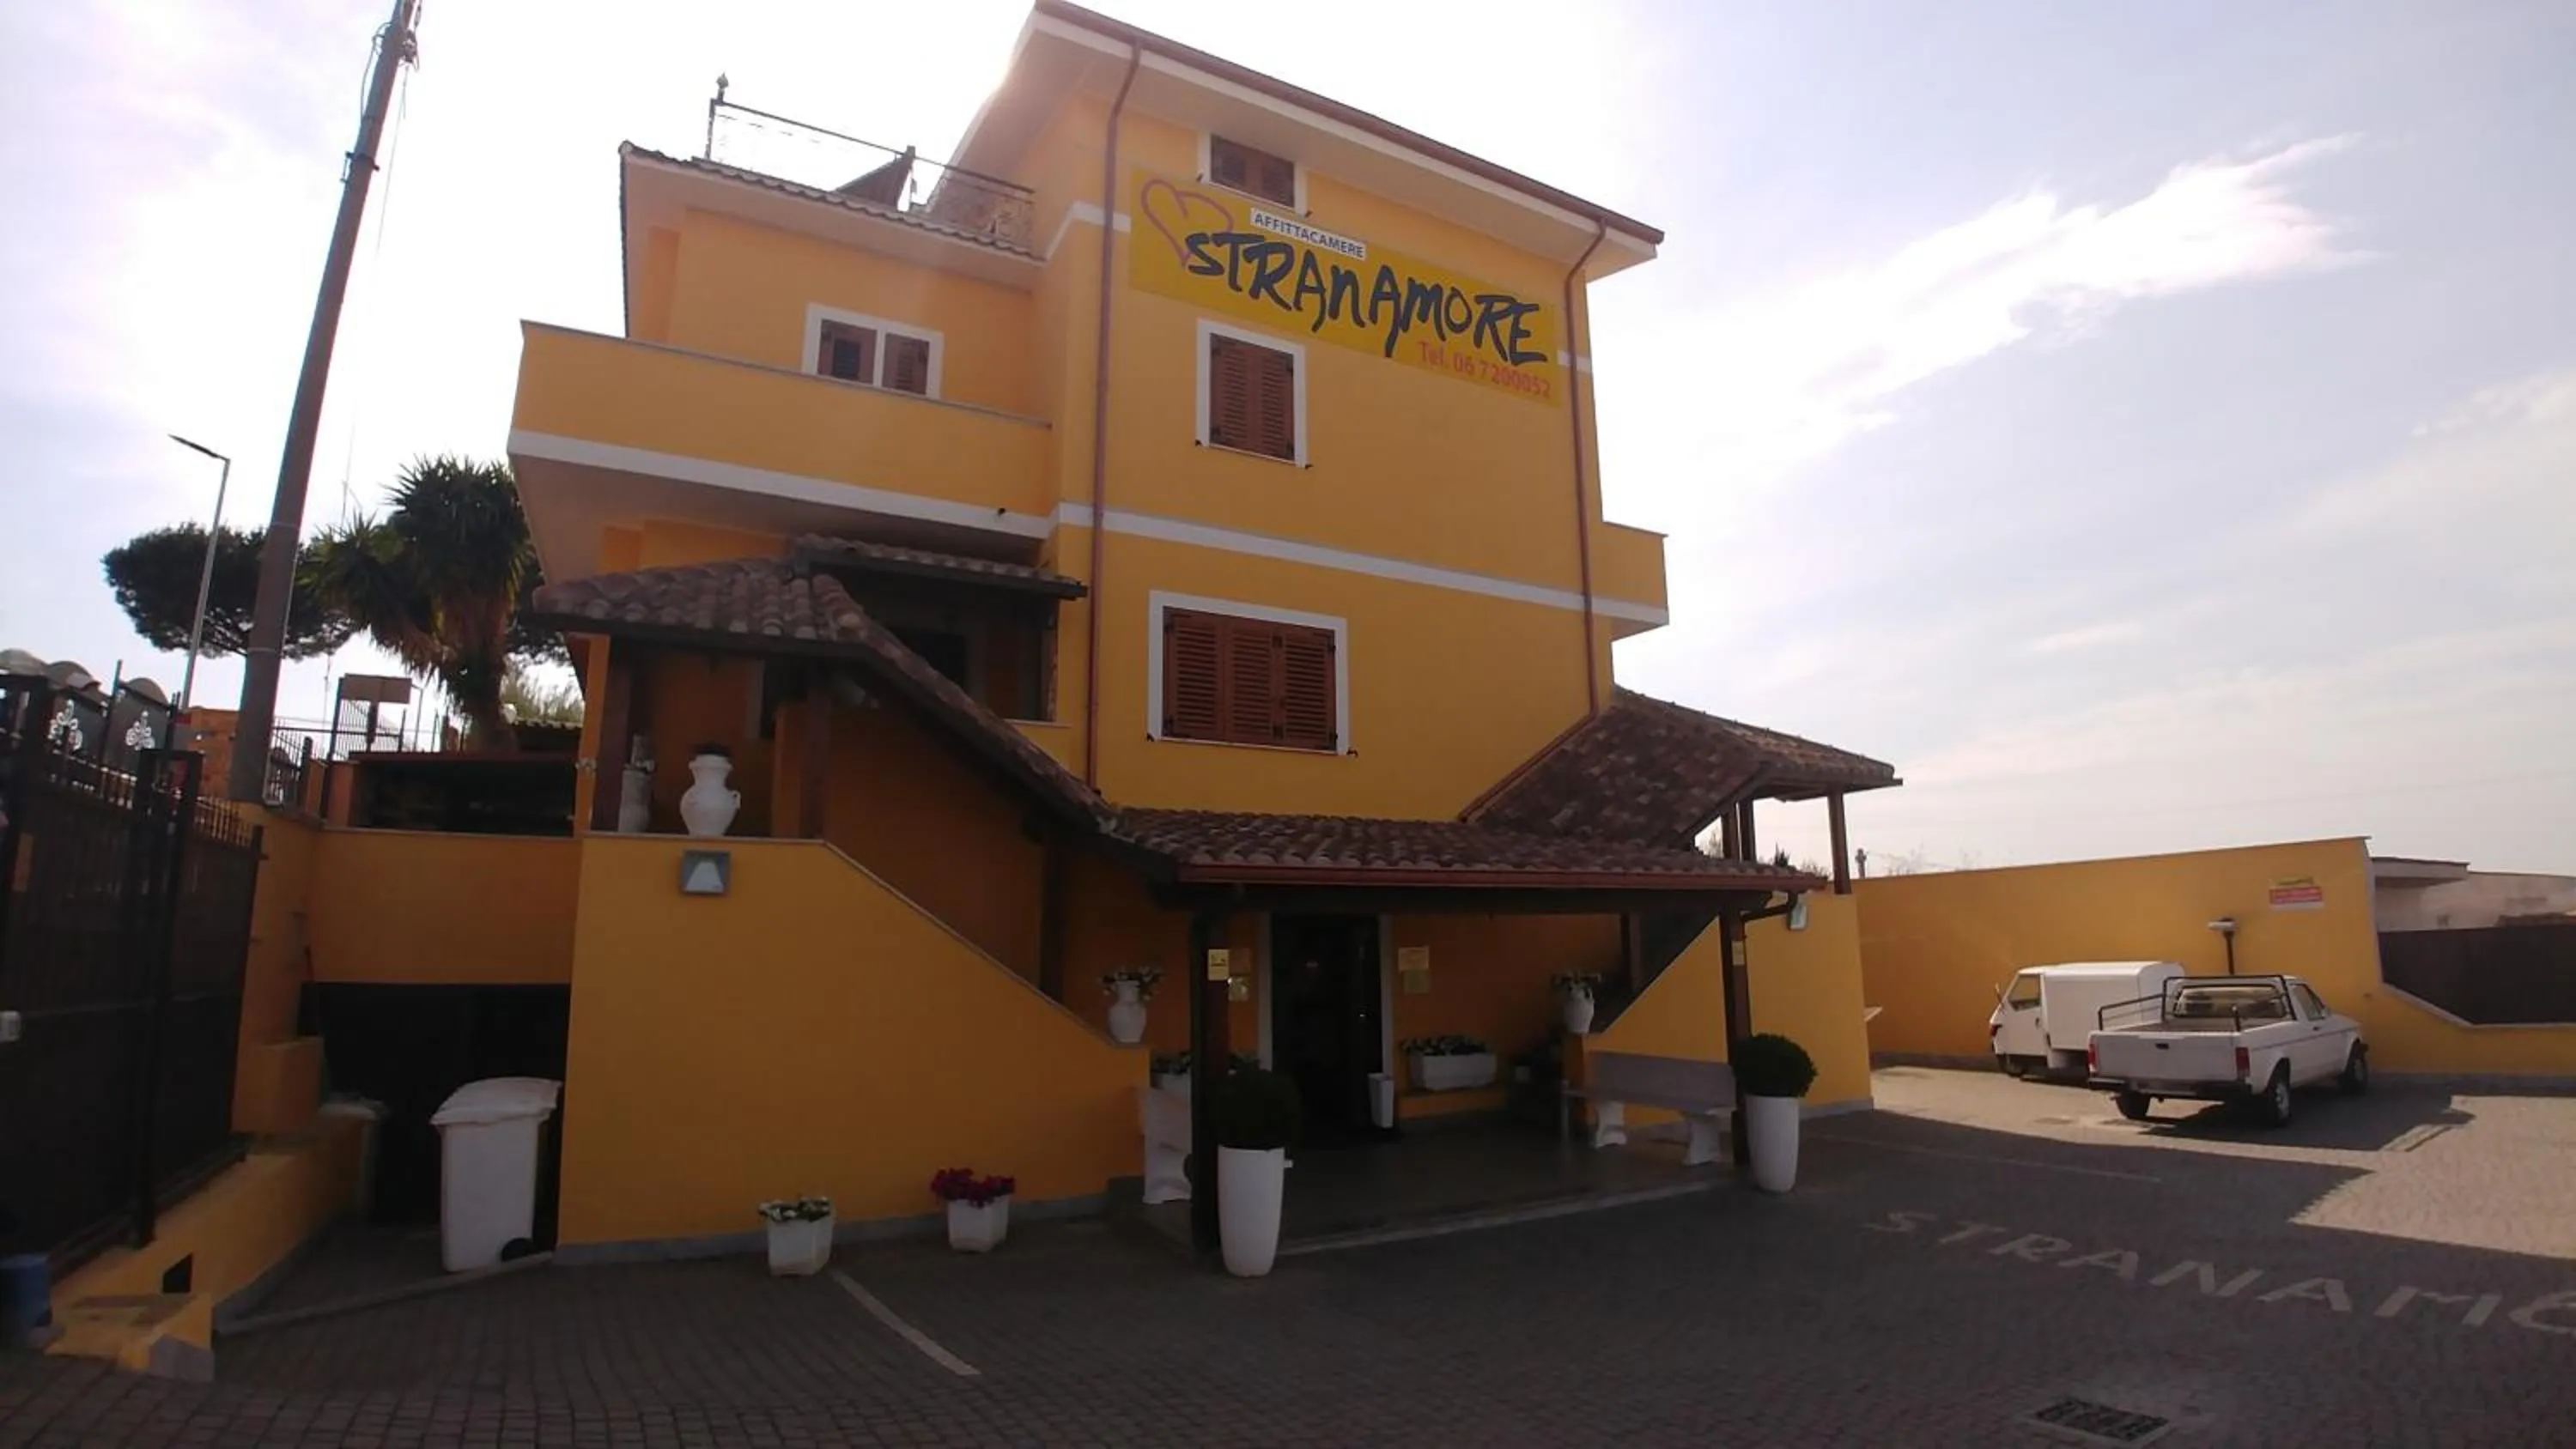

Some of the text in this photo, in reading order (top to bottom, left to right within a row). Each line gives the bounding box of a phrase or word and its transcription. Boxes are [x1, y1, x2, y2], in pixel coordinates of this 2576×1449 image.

[1255, 212, 1364, 258] AFFITTACAMERE
[1419, 341, 1449, 369] Tel.
[1452, 351, 1475, 377] 06
